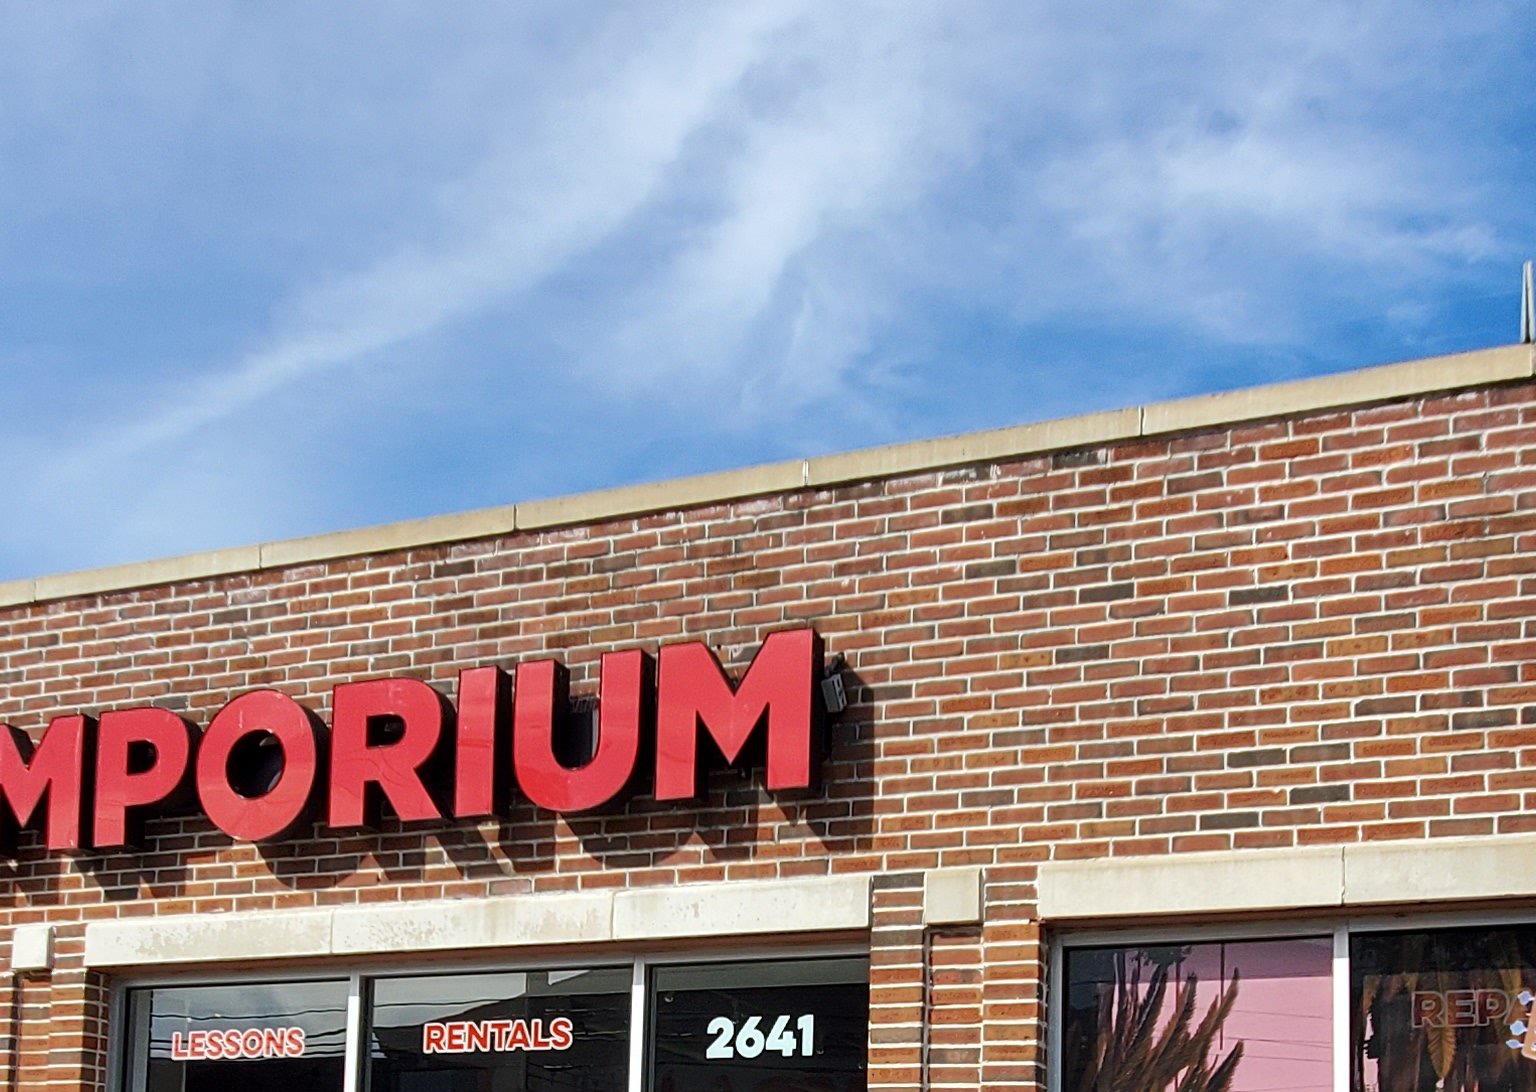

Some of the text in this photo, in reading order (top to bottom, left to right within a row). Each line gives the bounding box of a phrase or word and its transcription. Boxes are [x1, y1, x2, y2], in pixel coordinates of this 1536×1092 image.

[170, 1026, 306, 1061] LESSONS
[422, 1017, 574, 1056] RENTALS
[705, 1013, 815, 1060] 2641
